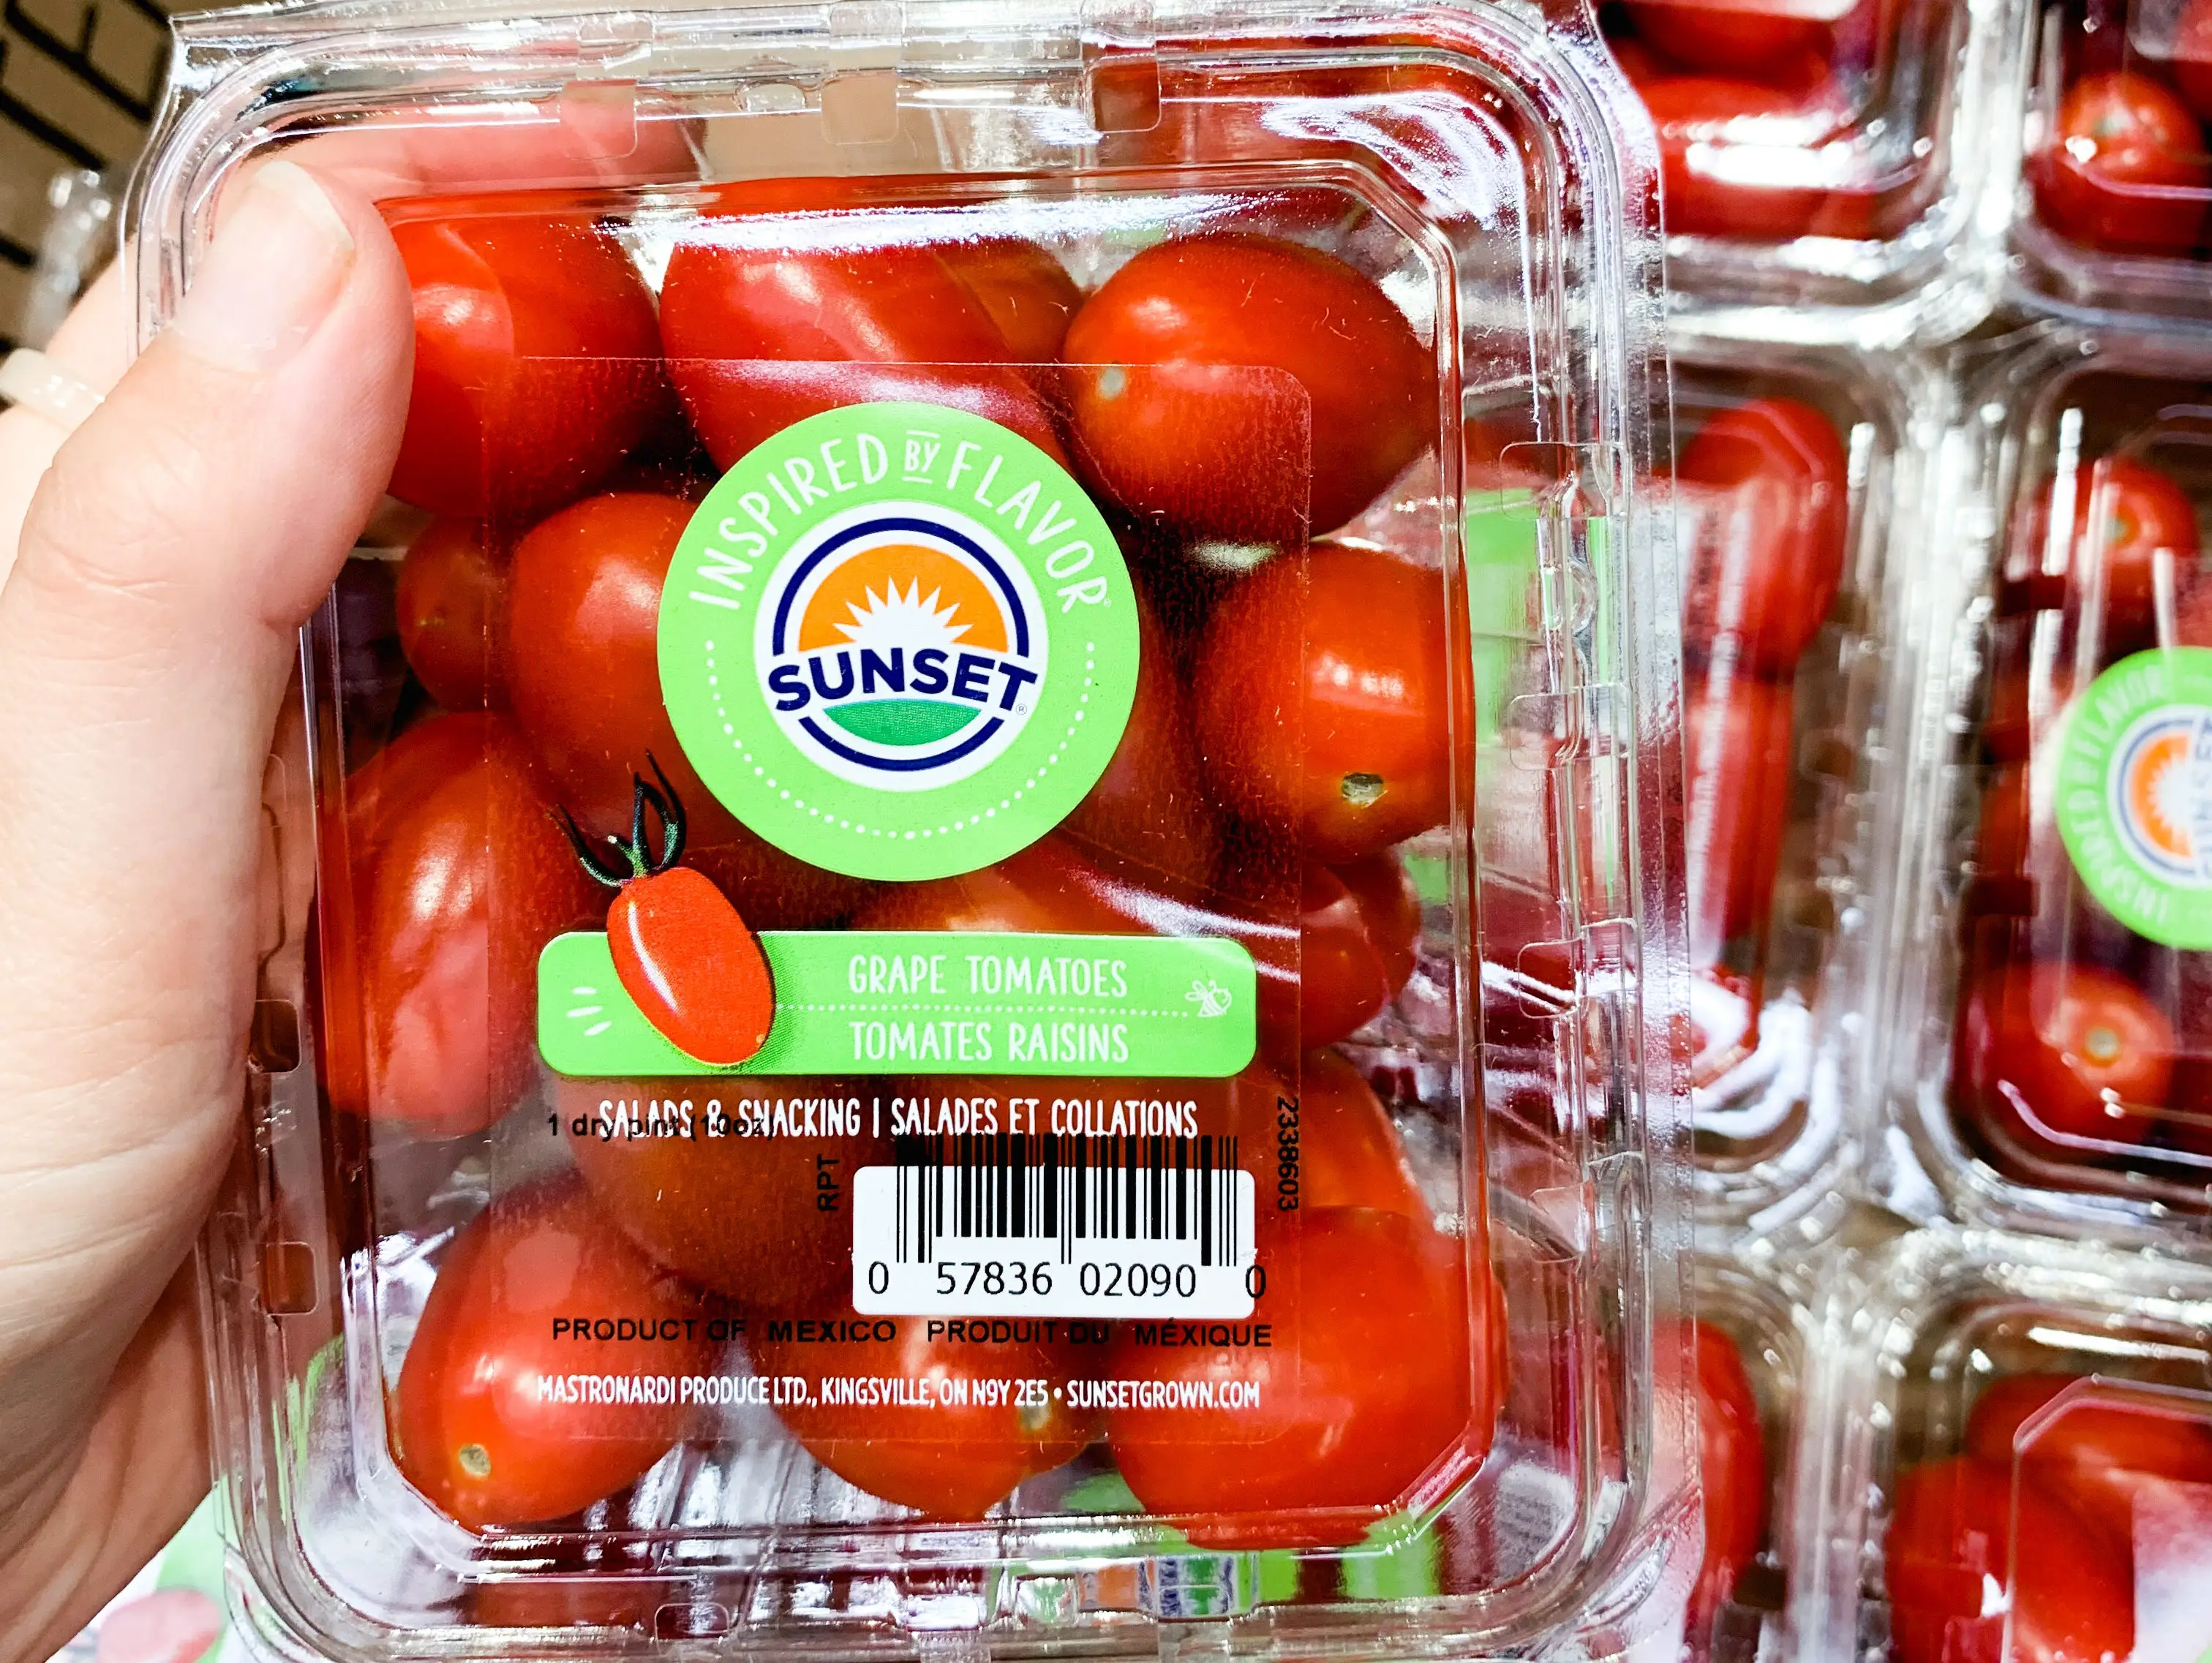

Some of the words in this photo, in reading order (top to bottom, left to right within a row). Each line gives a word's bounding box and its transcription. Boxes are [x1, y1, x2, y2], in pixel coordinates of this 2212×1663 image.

[689, 432, 888, 610] INSPIRED
[903, 440, 941, 473] BY
[946, 441, 1107, 614] FLAVOR
[767, 647, 1038, 712] SUNSET
[849, 954, 947, 994] GRAPE
[965, 955, 1129, 998] TOMATOES
[851, 1021, 993, 1062] TOMATES
[1009, 1022, 1129, 1063] RAISINS
[547, 1113, 558, 1136] 1
[599, 1099, 693, 1138] SALADS
[739, 1098, 861, 1138] SNACKING
[891, 1097, 998, 1137] SALADES
[1009, 1098, 1040, 1136] ET
[1051, 1099, 1198, 1139] COLLATIONS
[1277, 1096, 1299, 1212] 2338603
[817, 1153, 840, 1211] RPT
[868, 1262, 889, 1295] 0
[936, 1262, 1053, 1295] 57836
[1080, 1263, 1197, 1297] 02090
[1245, 1264, 1267, 1299] 0
[553, 1318, 693, 1341] PRODUCT
[707, 1319, 747, 1341] OF
[769, 1319, 896, 1342] MEXICO
[928, 1320, 1058, 1343] PRODUIT
[1069, 1321, 1110, 1345] DU
[1135, 1316, 1272, 1347] MÉXIQUE
[537, 1374, 675, 1405] MASTRONARDI
[680, 1376, 770, 1406] PRODUCE
[774, 1376, 817, 1408] LTD.,
[822, 1377, 936, 1409] KINGSVILLE,
[940, 1378, 968, 1406] ON
[973, 1379, 1010, 1407] N9Y
[1015, 1379, 1049, 1407] 2E5
[1066, 1379, 1260, 1409] SUNSETGROWN.COM
